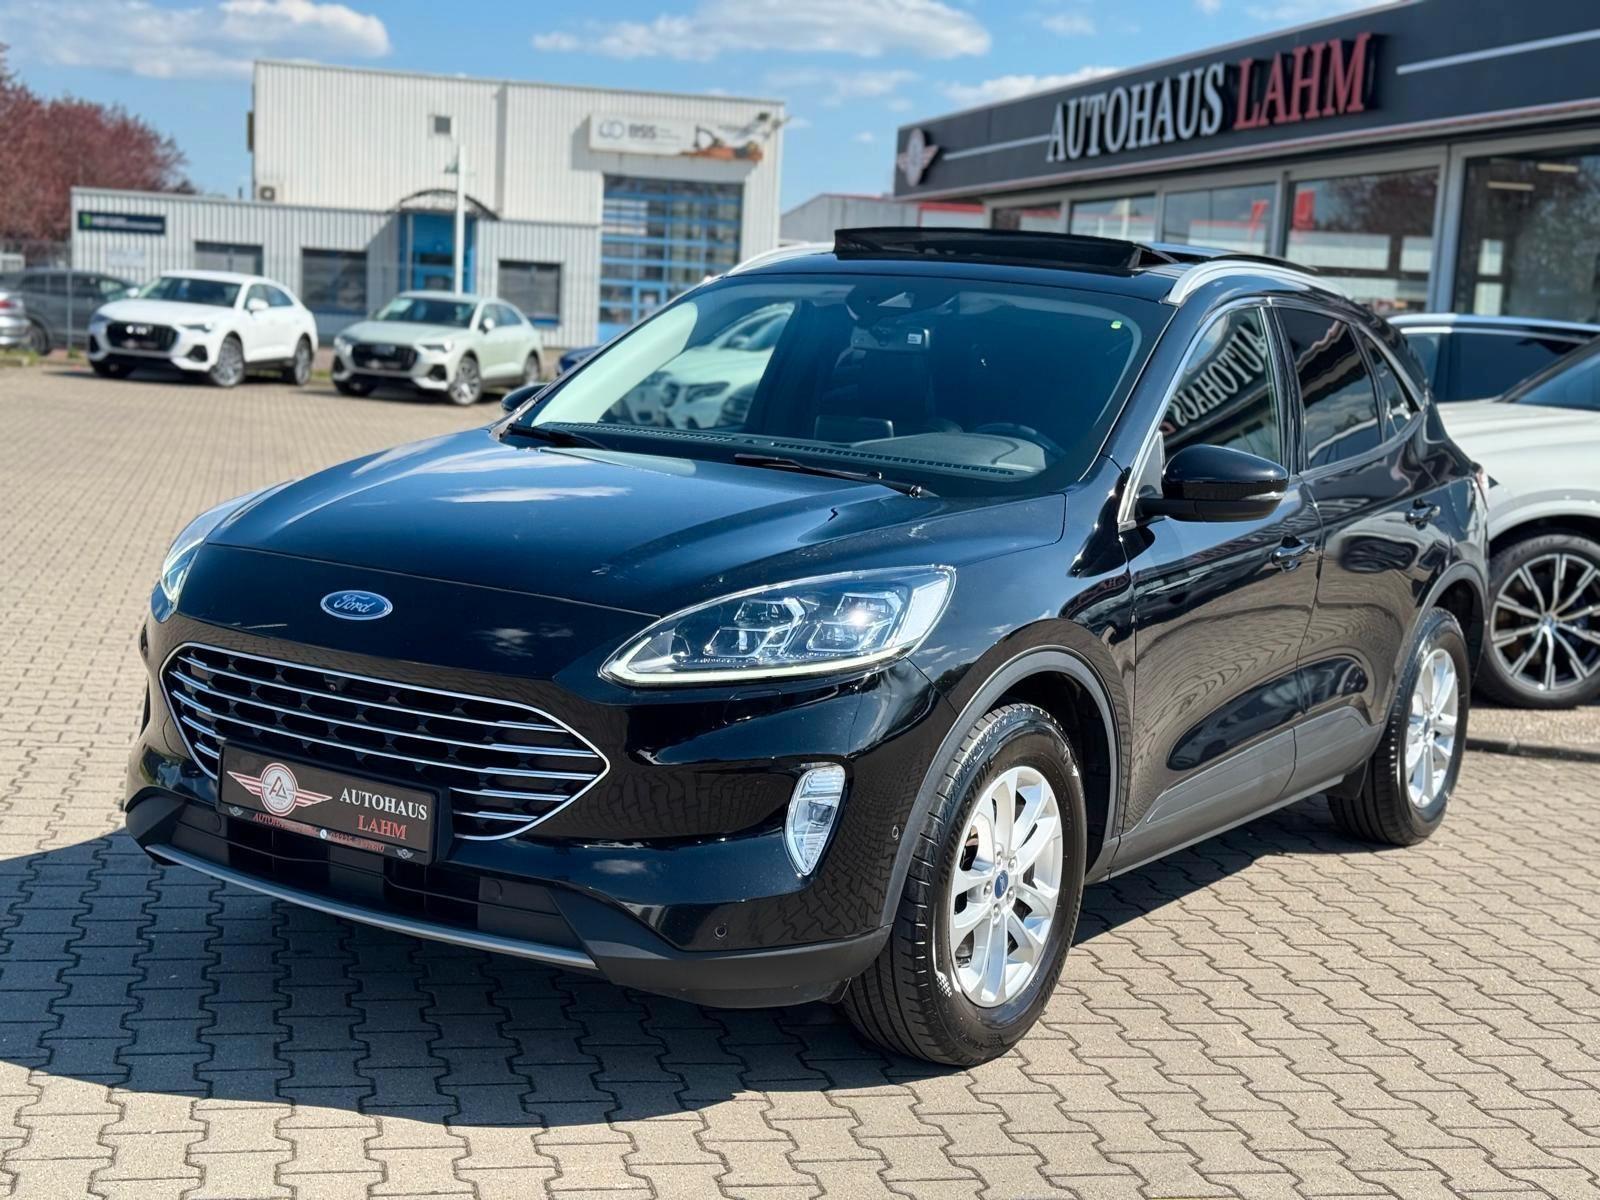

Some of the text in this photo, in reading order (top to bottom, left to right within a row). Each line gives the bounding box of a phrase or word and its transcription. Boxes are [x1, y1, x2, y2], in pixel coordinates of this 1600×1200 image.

[1046, 31, 1371, 163] AUTOHAUS LAHM
[333, 593, 376, 613] Ford
[339, 787, 428, 821] AUTOHAUS
[357, 814, 407, 840] LAHM
